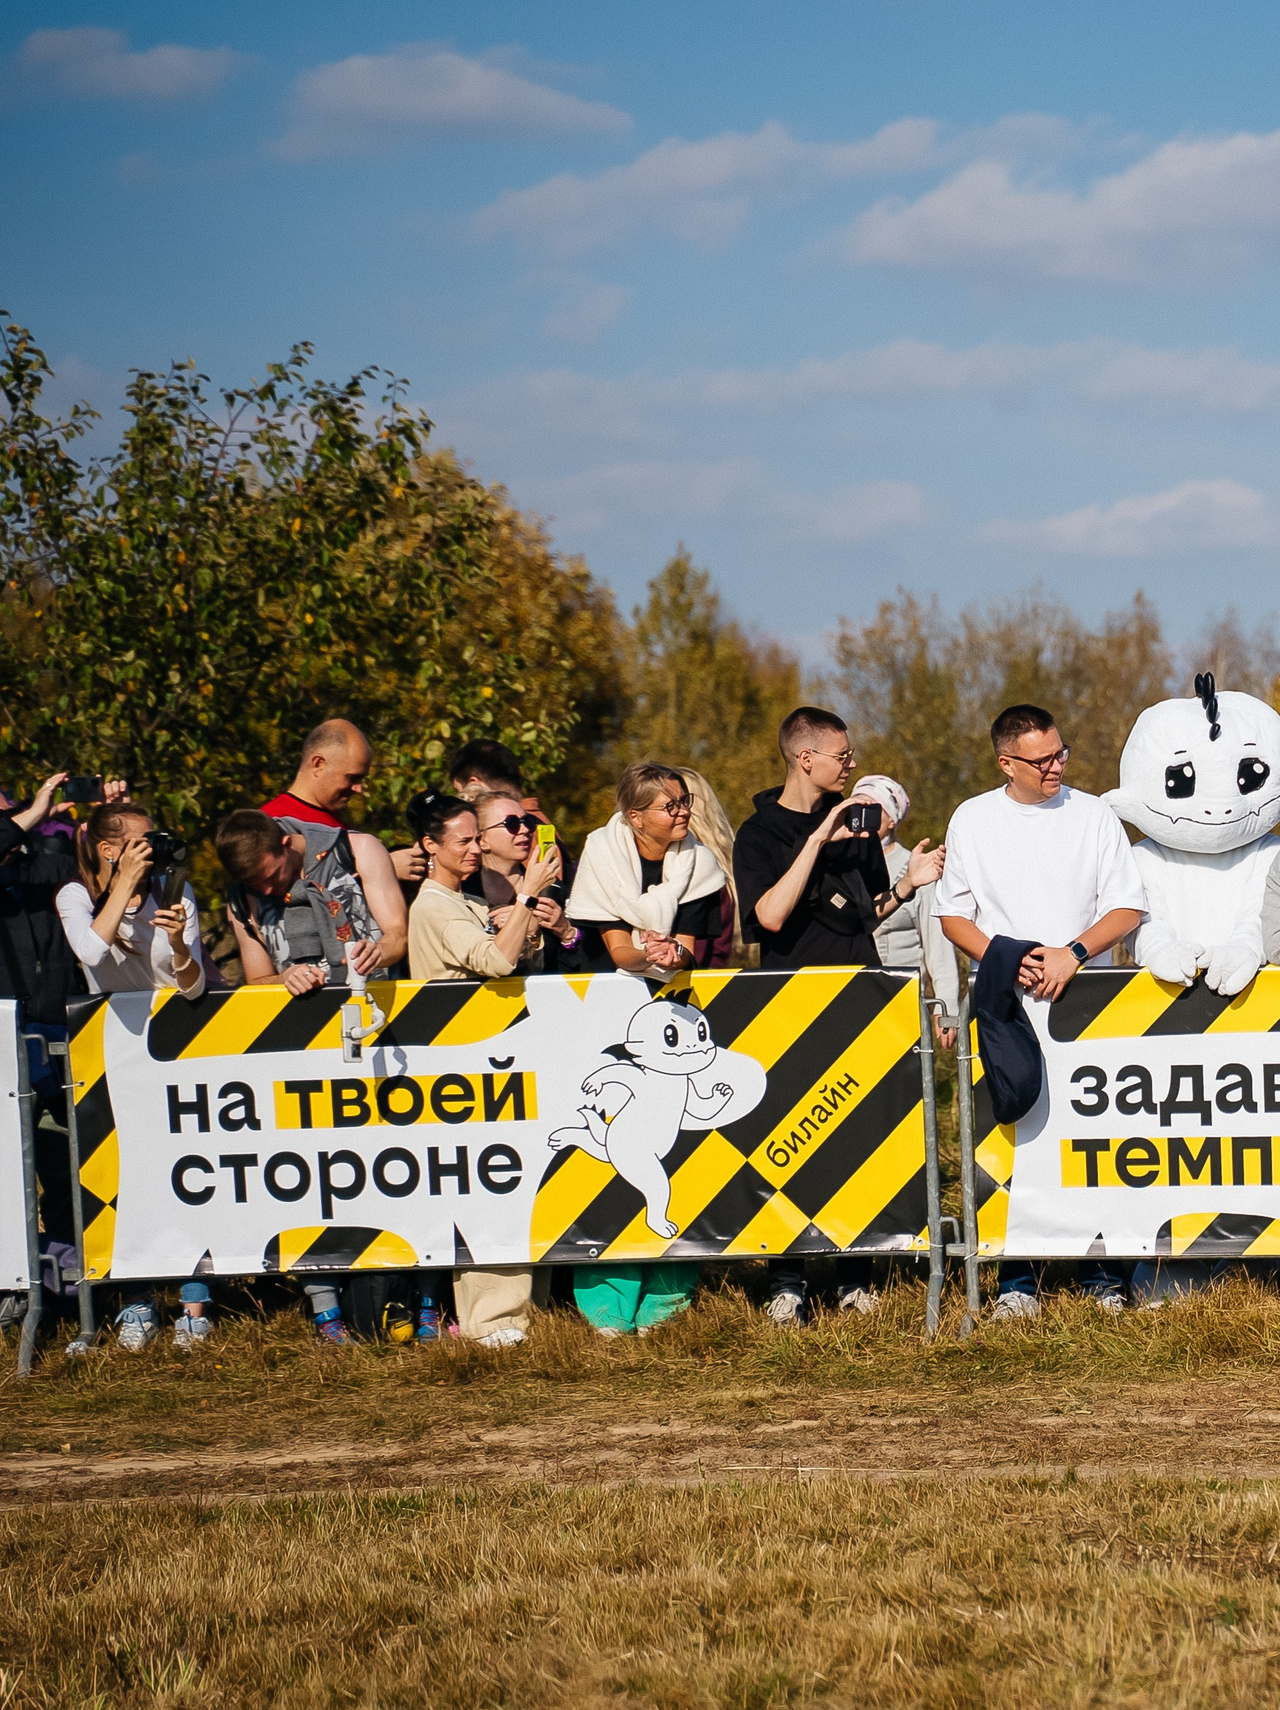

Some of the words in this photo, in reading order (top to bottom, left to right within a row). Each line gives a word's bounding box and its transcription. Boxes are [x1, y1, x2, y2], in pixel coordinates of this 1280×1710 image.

[167, 1082, 261, 1134] на
[285, 1057, 526, 1129] твоей
[766, 1073, 860, 1168] билайн
[171, 1144, 523, 1220] стороне
[1072, 1136, 1273, 1188] темп
